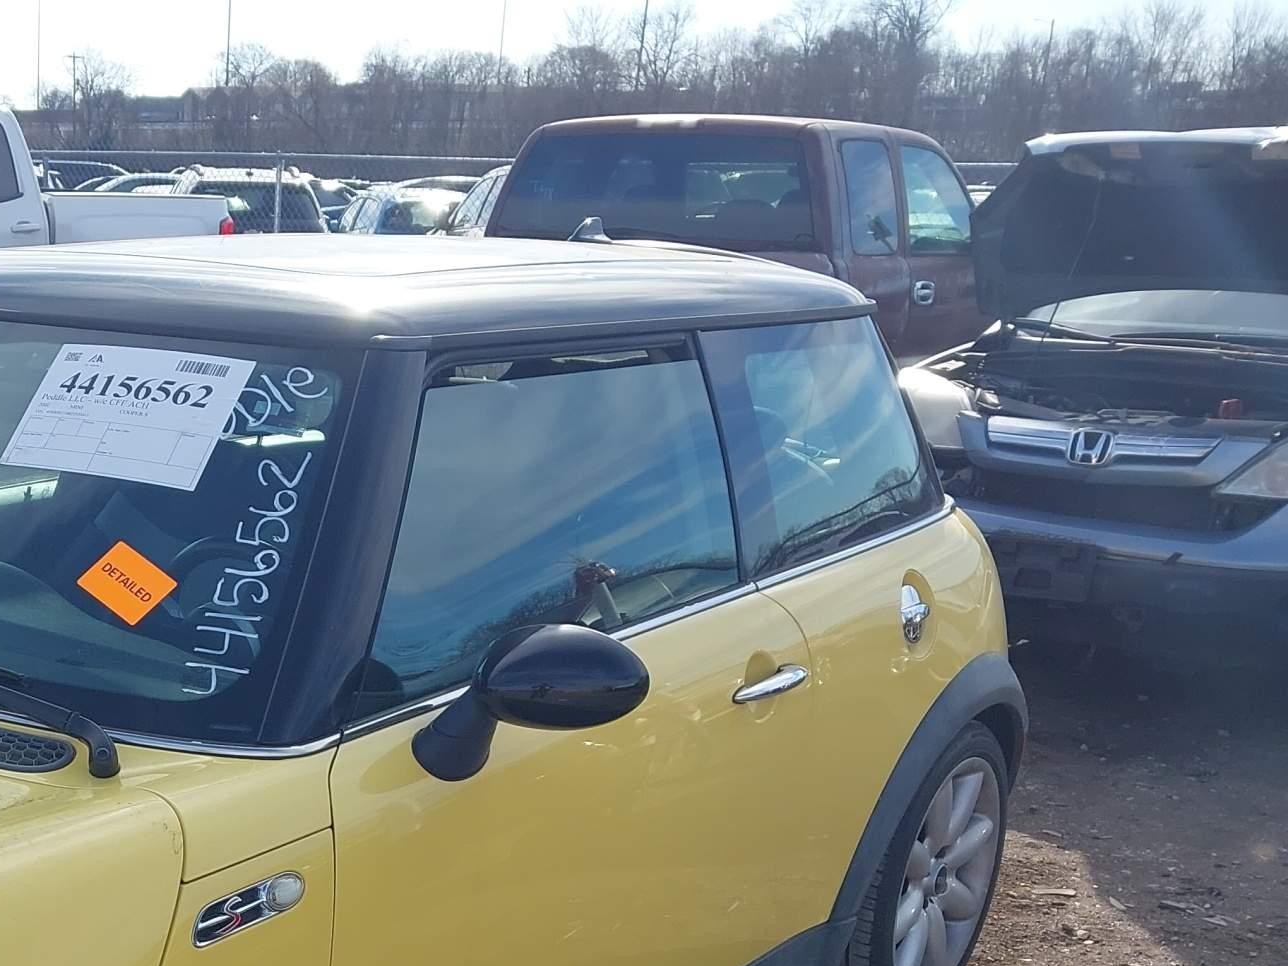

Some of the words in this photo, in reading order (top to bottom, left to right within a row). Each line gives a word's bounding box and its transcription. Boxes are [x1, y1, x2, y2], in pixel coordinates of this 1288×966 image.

[59, 372, 213, 408] 44156562
[101, 562, 152, 602] DETAILED
[182, 451, 312, 695] 44156562
